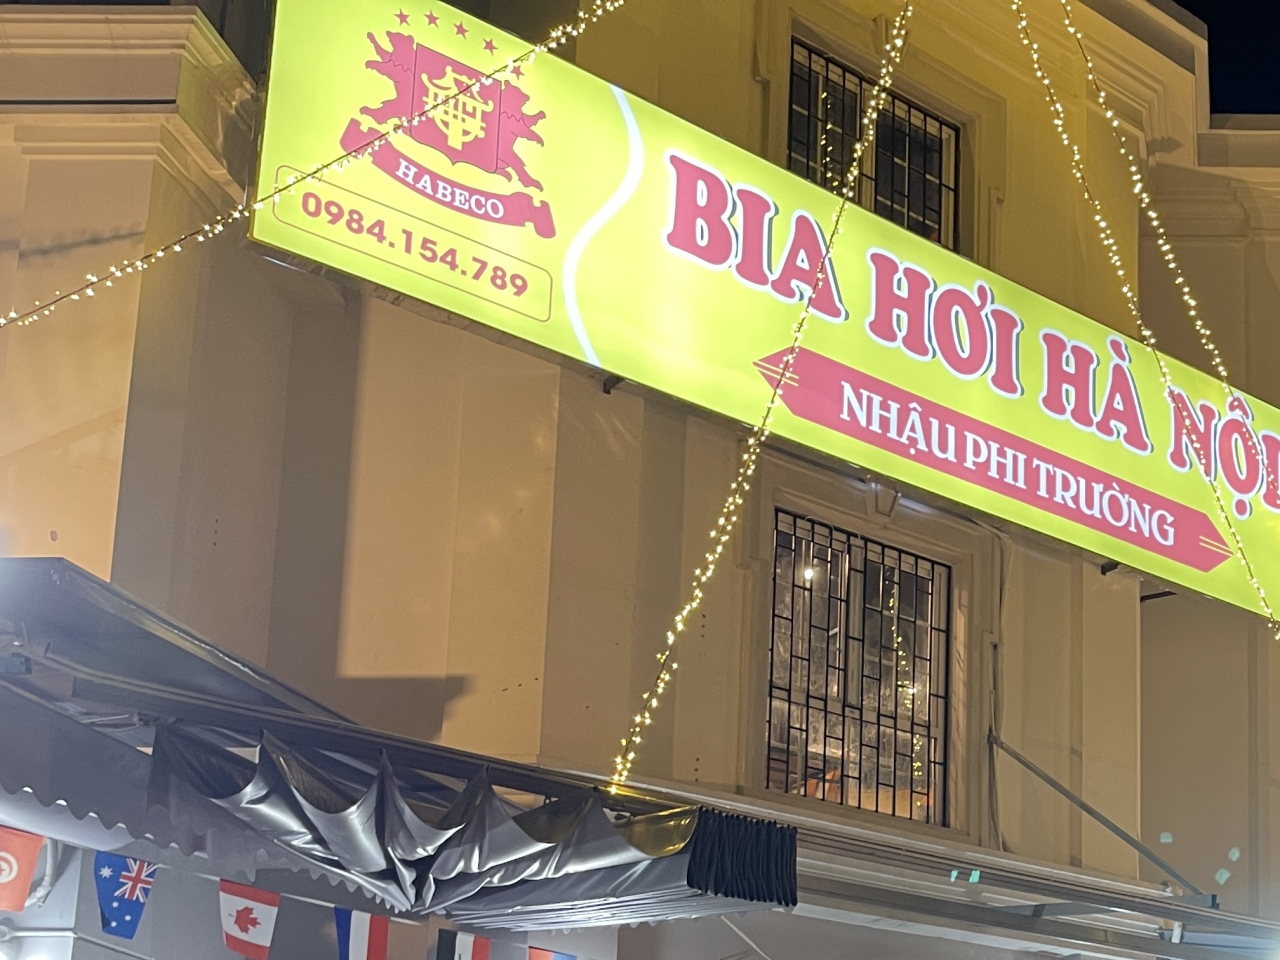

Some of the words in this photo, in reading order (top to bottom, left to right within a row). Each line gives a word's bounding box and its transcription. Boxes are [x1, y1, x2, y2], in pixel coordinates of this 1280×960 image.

[301, 191, 528, 297] 0984.154.789
[395, 158, 505, 219] HABECO
[665, 150, 849, 323] BIA
[865, 247, 1023, 399] HƠI
[1039, 328, 1154, 456] HÀ
[840, 380, 957, 463] NHẬU
[963, 430, 1027, 490] PHI
[1032, 457, 1175, 547] TRƯỜNG
